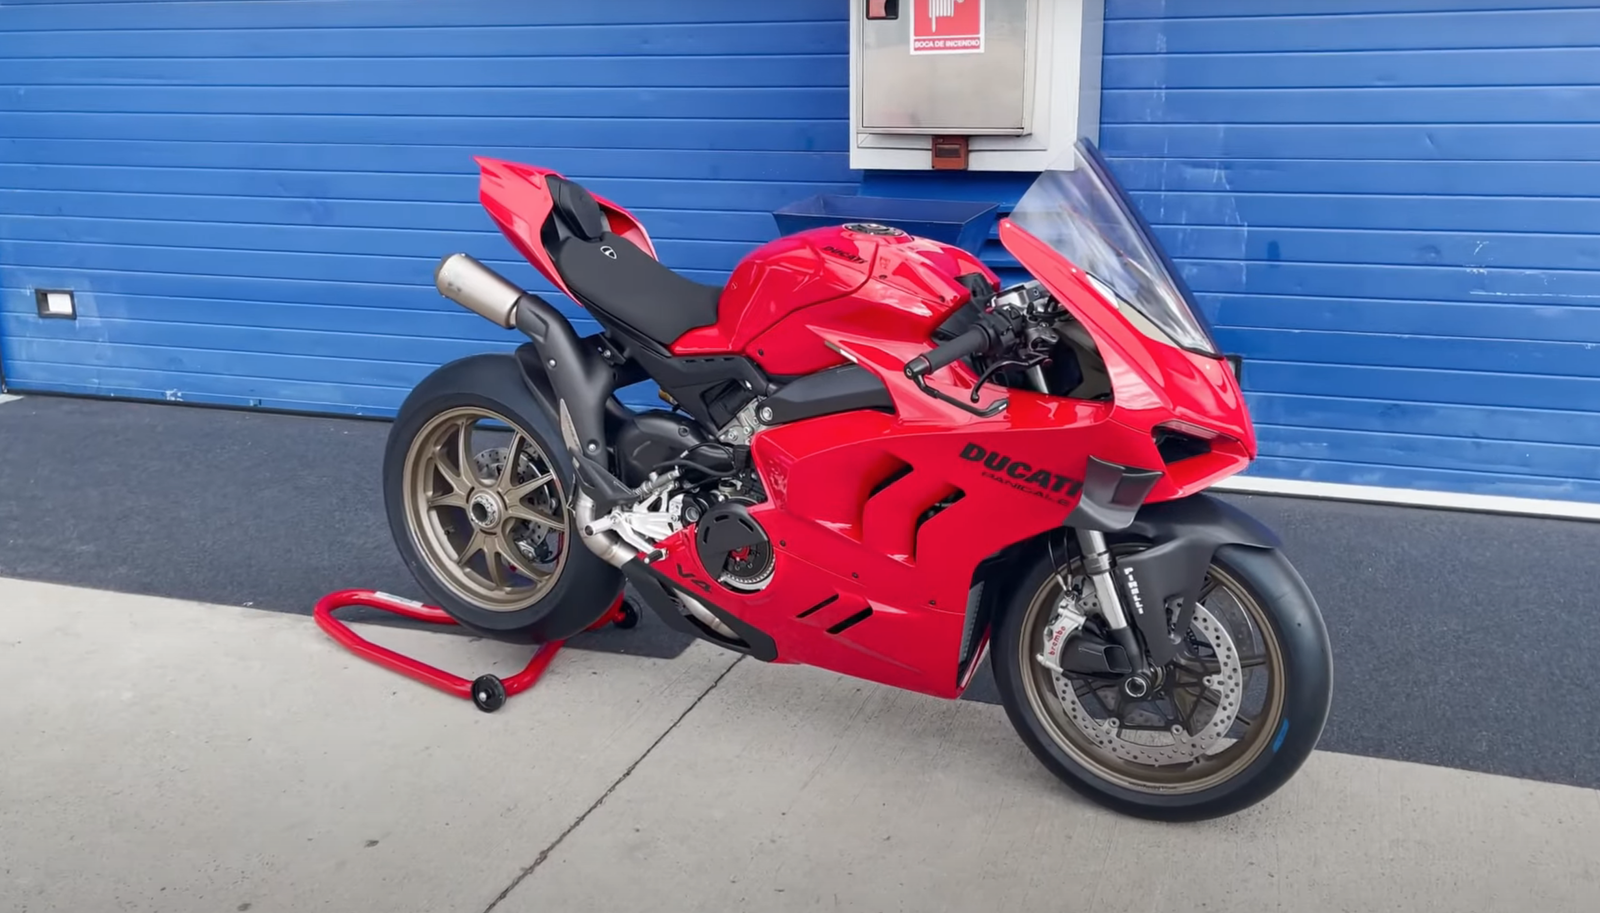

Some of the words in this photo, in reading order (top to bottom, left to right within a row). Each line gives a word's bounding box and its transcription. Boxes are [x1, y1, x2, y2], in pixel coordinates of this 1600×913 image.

[935, 40, 945, 48] DE
[946, 39, 980, 47] INCENDIO
[960, 442, 1083, 497] DUCATI
[676, 563, 712, 594] V4
[1048, 626, 1066, 656] brembo
